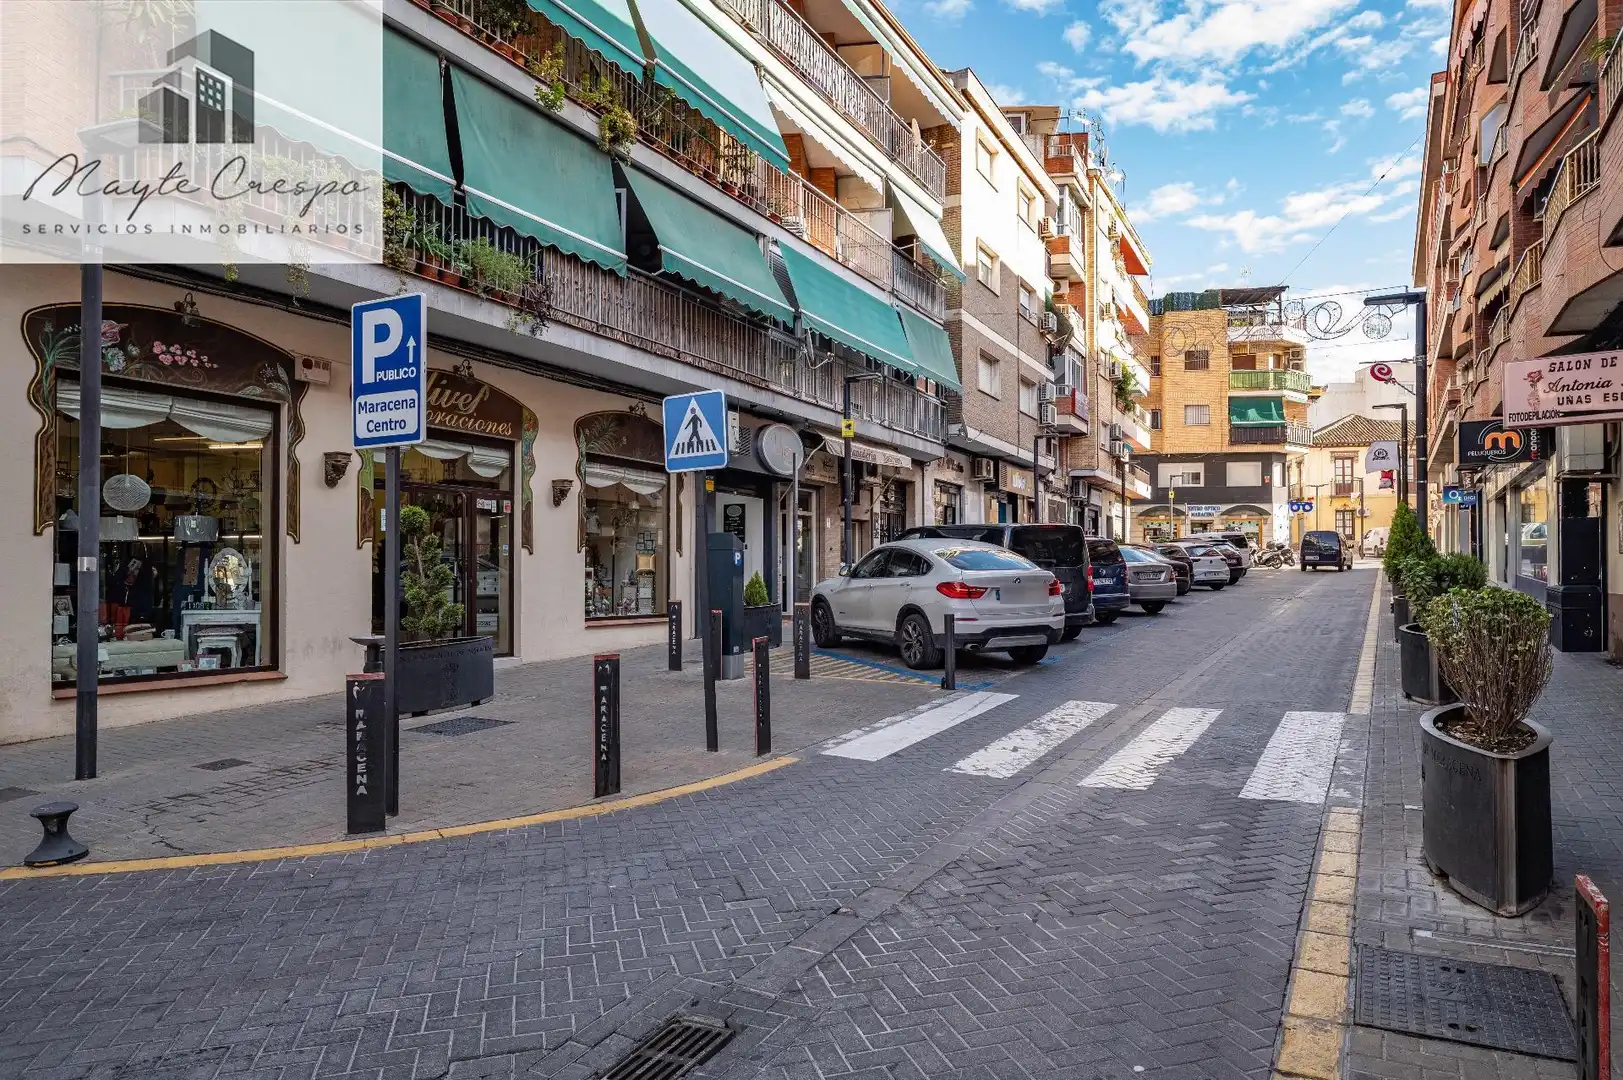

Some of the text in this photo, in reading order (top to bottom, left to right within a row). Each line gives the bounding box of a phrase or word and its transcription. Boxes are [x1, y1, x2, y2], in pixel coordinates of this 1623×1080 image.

[362, 308, 404, 385] P
[1548, 356, 1618, 373] SALON DE
[376, 366, 417, 382] PUBLICO
[1543, 377, 1614, 394] Antonia
[357, 397, 416, 414] Maracena
[1557, 394, 1592, 406] UÑAS
[366, 418, 407, 433] Centro
[1467, 448, 1507, 457] PELUQUEROS
[600, 685, 608, 761] MARACENA
